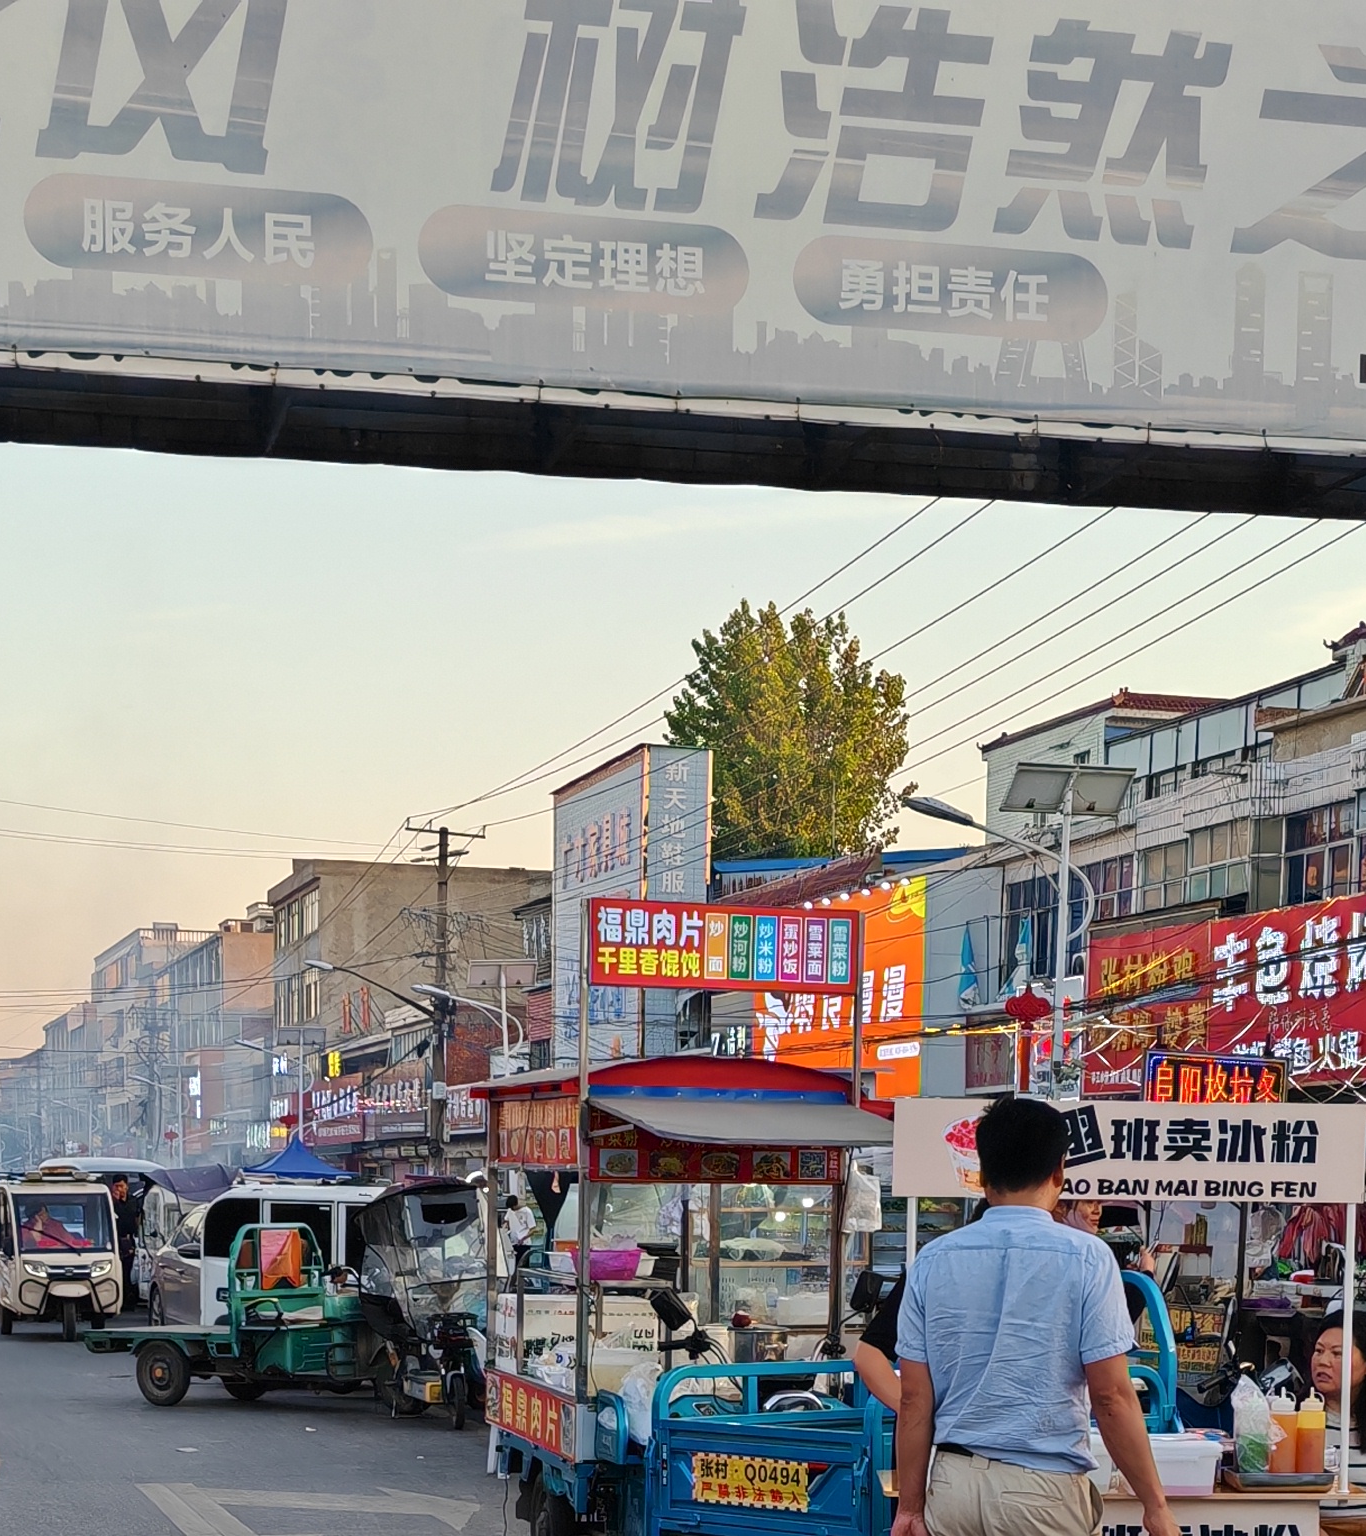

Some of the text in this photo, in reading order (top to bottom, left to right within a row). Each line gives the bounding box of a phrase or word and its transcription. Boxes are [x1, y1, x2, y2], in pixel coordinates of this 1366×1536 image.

[81, 198, 316, 269] 服务人民
[484, 228, 706, 297] 坚定理想
[838, 257, 1049, 324] 勇担责任
[597, 906, 704, 947] 福鼎肉片
[733, 921, 748, 974] 炒河粉
[757, 923, 774, 975] 炒米粉
[597, 946, 701, 978] 千里香馄饨
[1097, 1179, 1149, 1197] BAN
[1155, 1180, 1198, 1197] MAI
[1204, 1180, 1264, 1198] BING
[1269, 1181, 1317, 1198] FEN
[501, 1380, 559, 1449] 福鼎肉片
